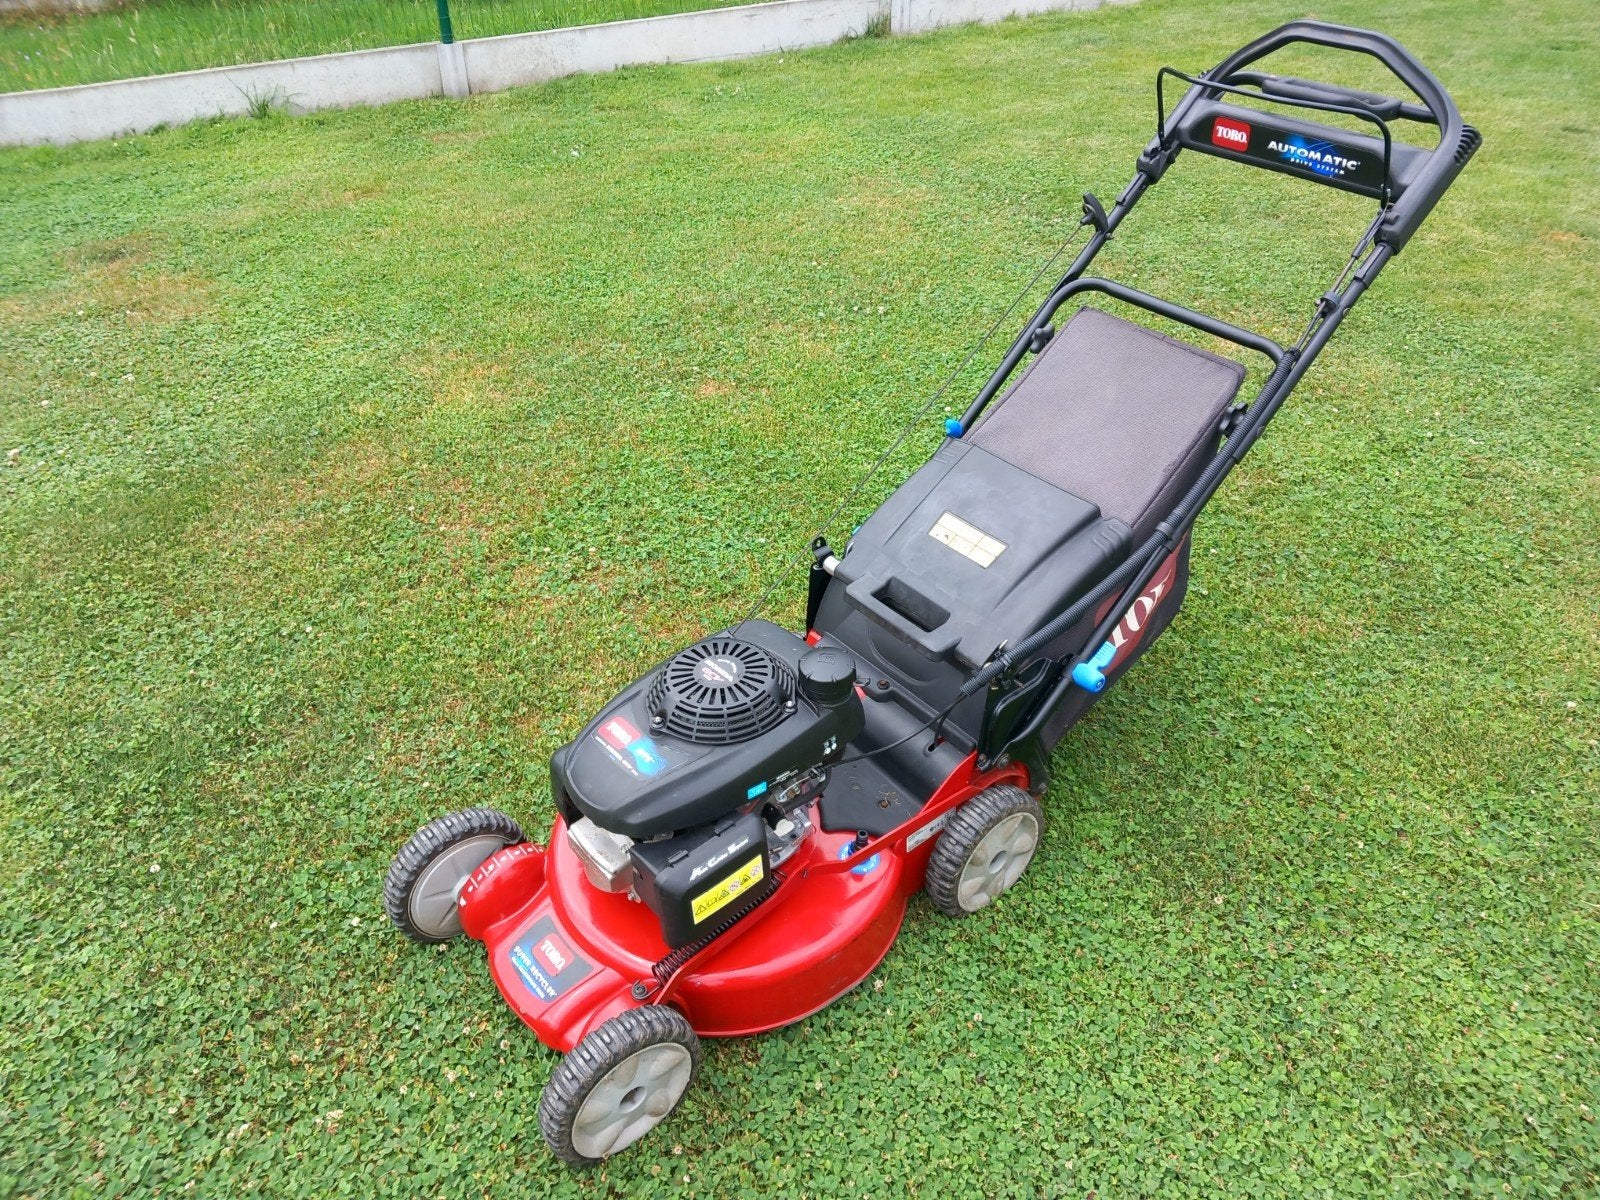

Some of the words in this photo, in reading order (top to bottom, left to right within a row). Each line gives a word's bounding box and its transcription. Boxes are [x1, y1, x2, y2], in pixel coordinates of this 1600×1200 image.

[1267, 140, 1360, 170] AUTOMATIC
[1290, 157, 1313, 167] DRIVE
[1316, 164, 1345, 175] SYSTEM
[513, 945, 532, 967] SUPER
[530, 965, 556, 997] RECYCLER
